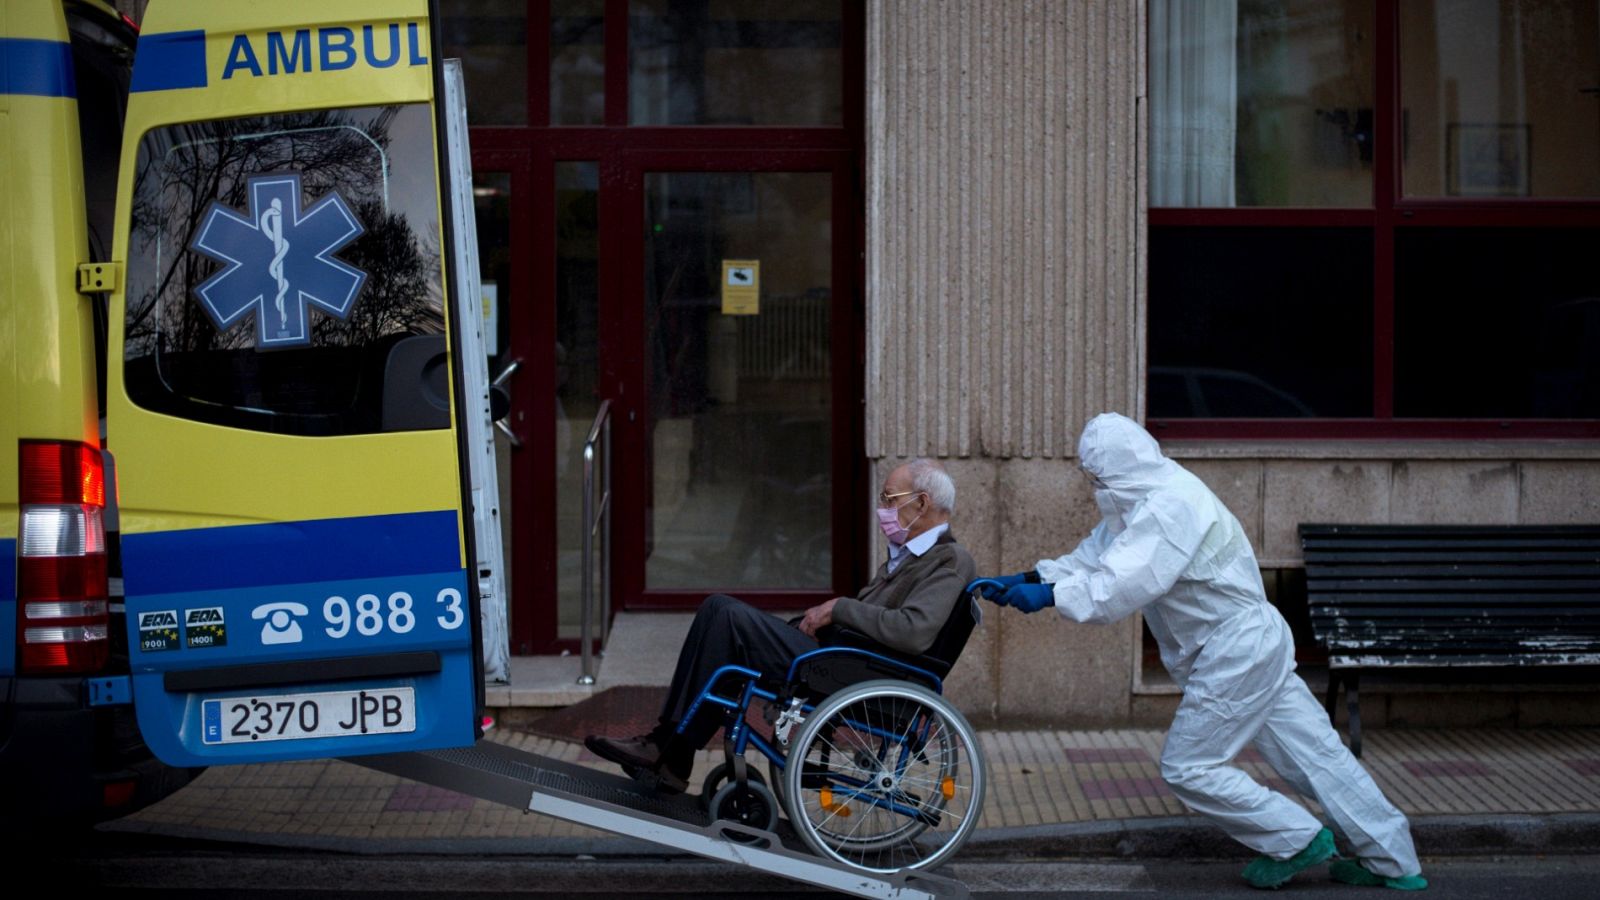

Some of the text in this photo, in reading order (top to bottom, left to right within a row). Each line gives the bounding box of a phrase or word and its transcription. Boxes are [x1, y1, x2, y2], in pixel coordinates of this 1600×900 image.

[222, 22, 428, 79] AMBUL
[323, 587, 464, 639] 988 3
[145, 639, 166, 648] 9001
[191, 636, 213, 645] 14001
[231, 694, 402, 736] 2370 JPB
[209, 726, 217, 736] E
